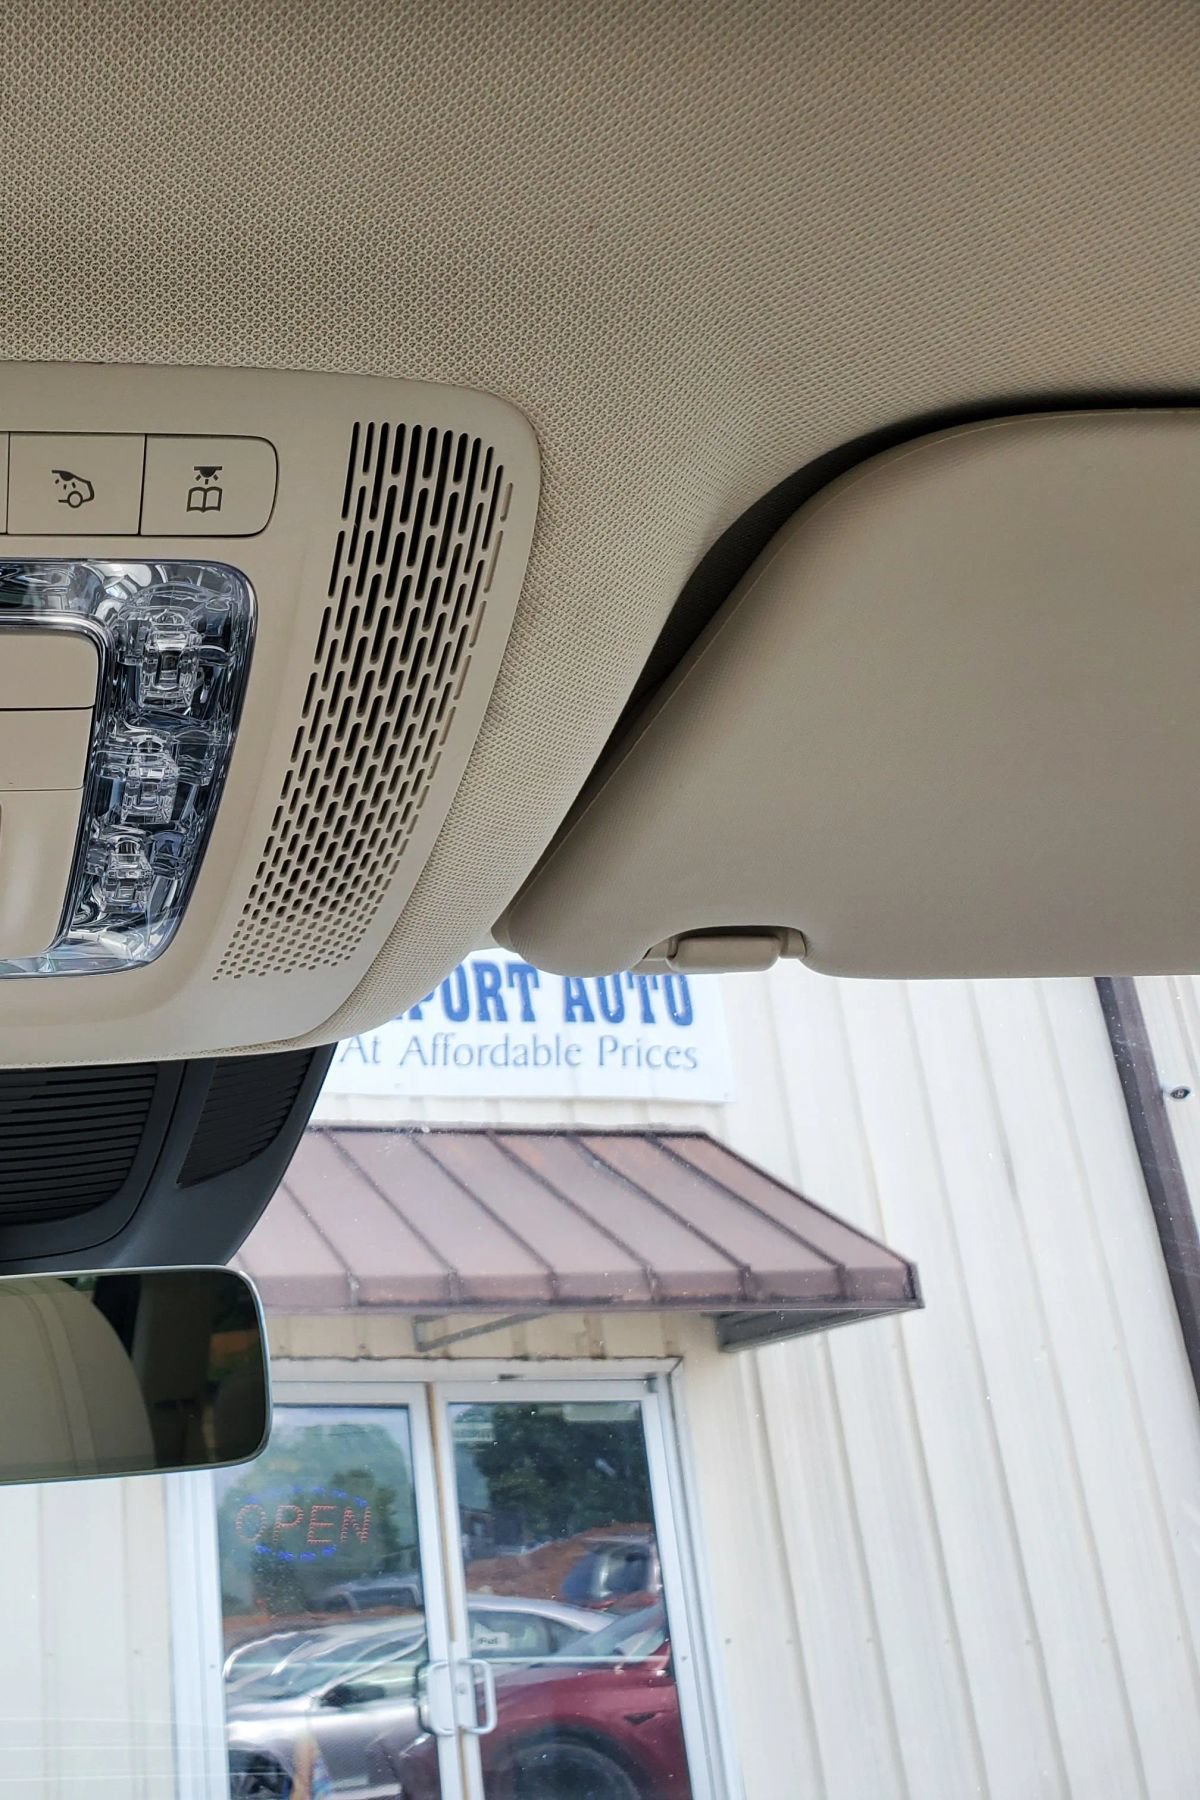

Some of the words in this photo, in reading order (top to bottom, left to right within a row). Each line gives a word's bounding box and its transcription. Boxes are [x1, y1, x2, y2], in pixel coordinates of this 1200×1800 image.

[563, 972, 694, 1026] AUTO
[340, 1034, 382, 1065] At
[399, 1032, 583, 1067] Affordable
[598, 1034, 699, 1069] Prices
[235, 1503, 372, 1545] OPEN
